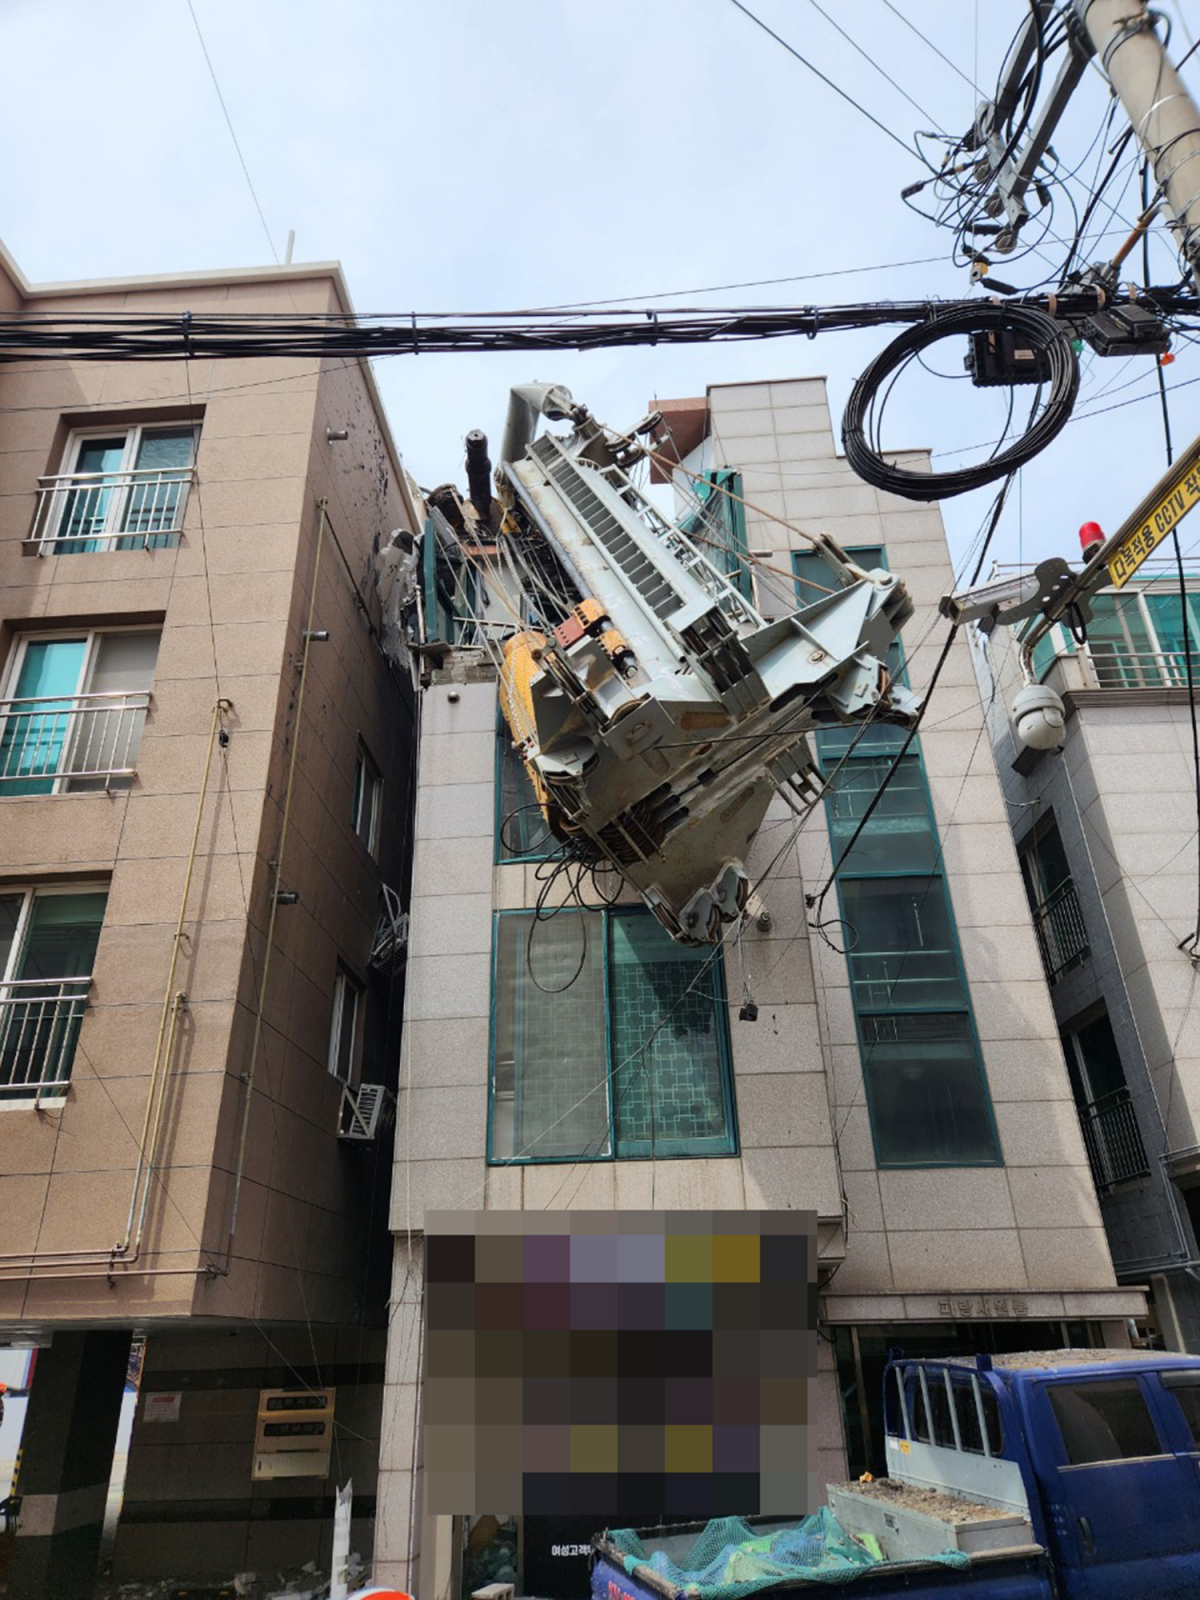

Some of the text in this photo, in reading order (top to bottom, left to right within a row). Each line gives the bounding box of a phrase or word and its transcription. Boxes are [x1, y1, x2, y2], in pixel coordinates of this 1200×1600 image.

[1154, 489, 1186, 533] CCTV
[1184, 466, 1200, 496] 작
[938, 1298, 1028, 1317] 파랑새원룸
